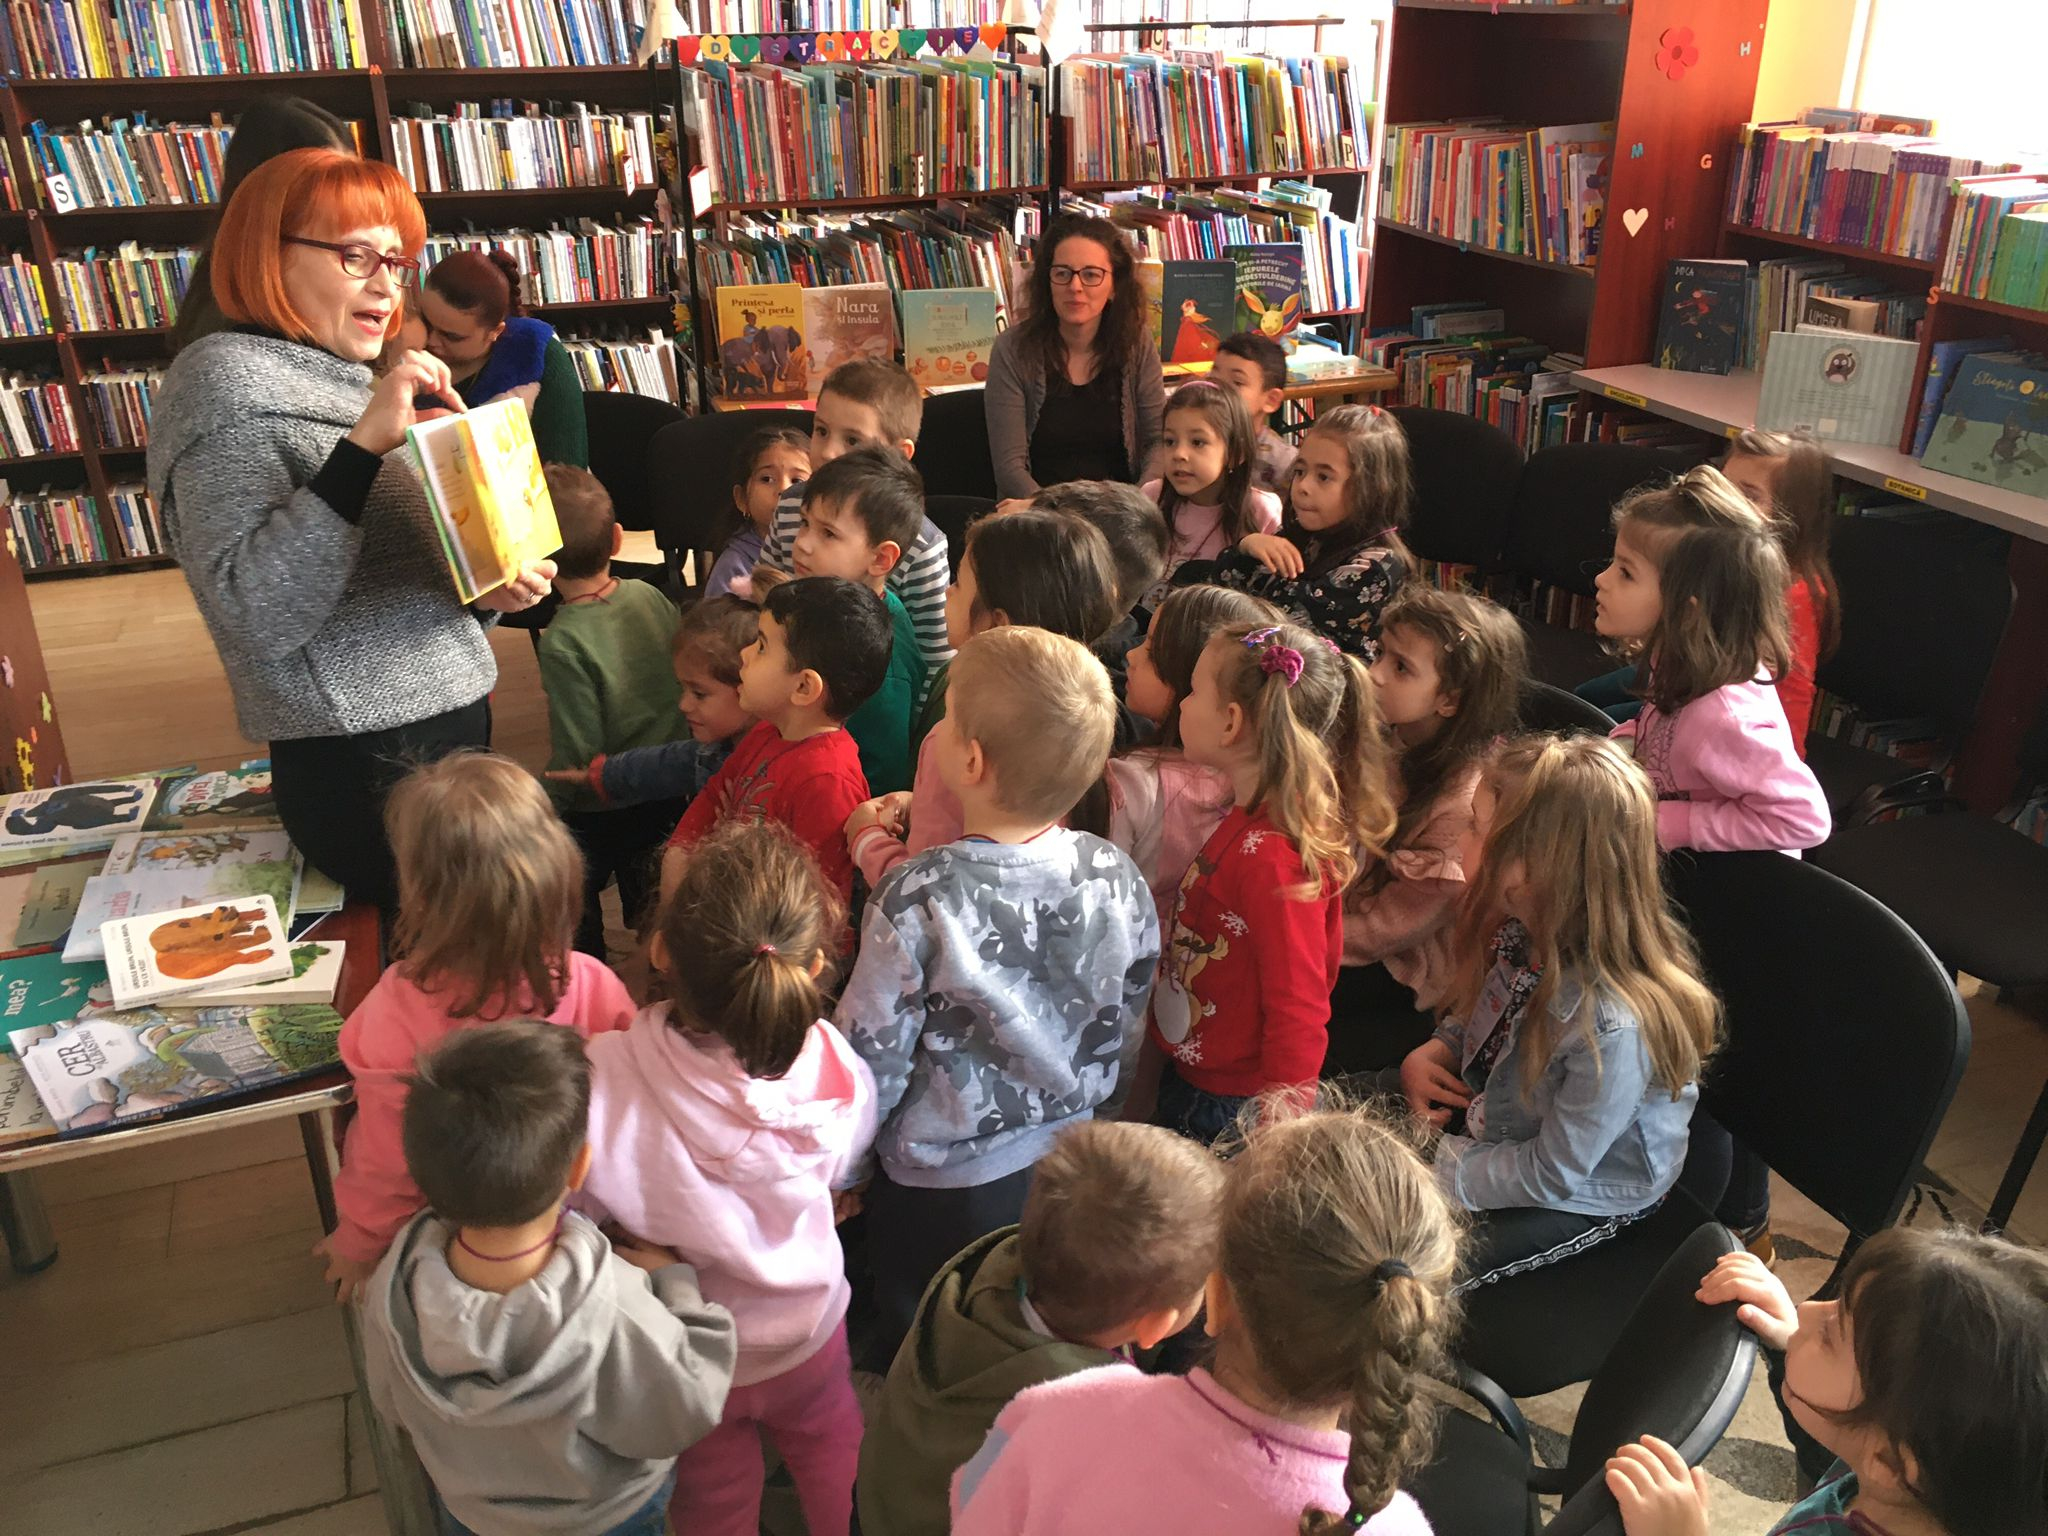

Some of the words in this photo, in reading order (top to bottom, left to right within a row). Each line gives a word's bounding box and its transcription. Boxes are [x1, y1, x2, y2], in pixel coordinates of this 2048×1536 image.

[1275, 142, 1287, 168] N
[1344, 143, 1353, 162] P
[1631, 142, 1644, 159] M
[1700, 154, 1712, 169] G
[54, 182, 69, 205] S
[836, 296, 880, 314] Nara
[1926, 286, 1940, 305] S
[4, 979, 33, 1016] mea?
[57, 1042, 96, 1077] CER
